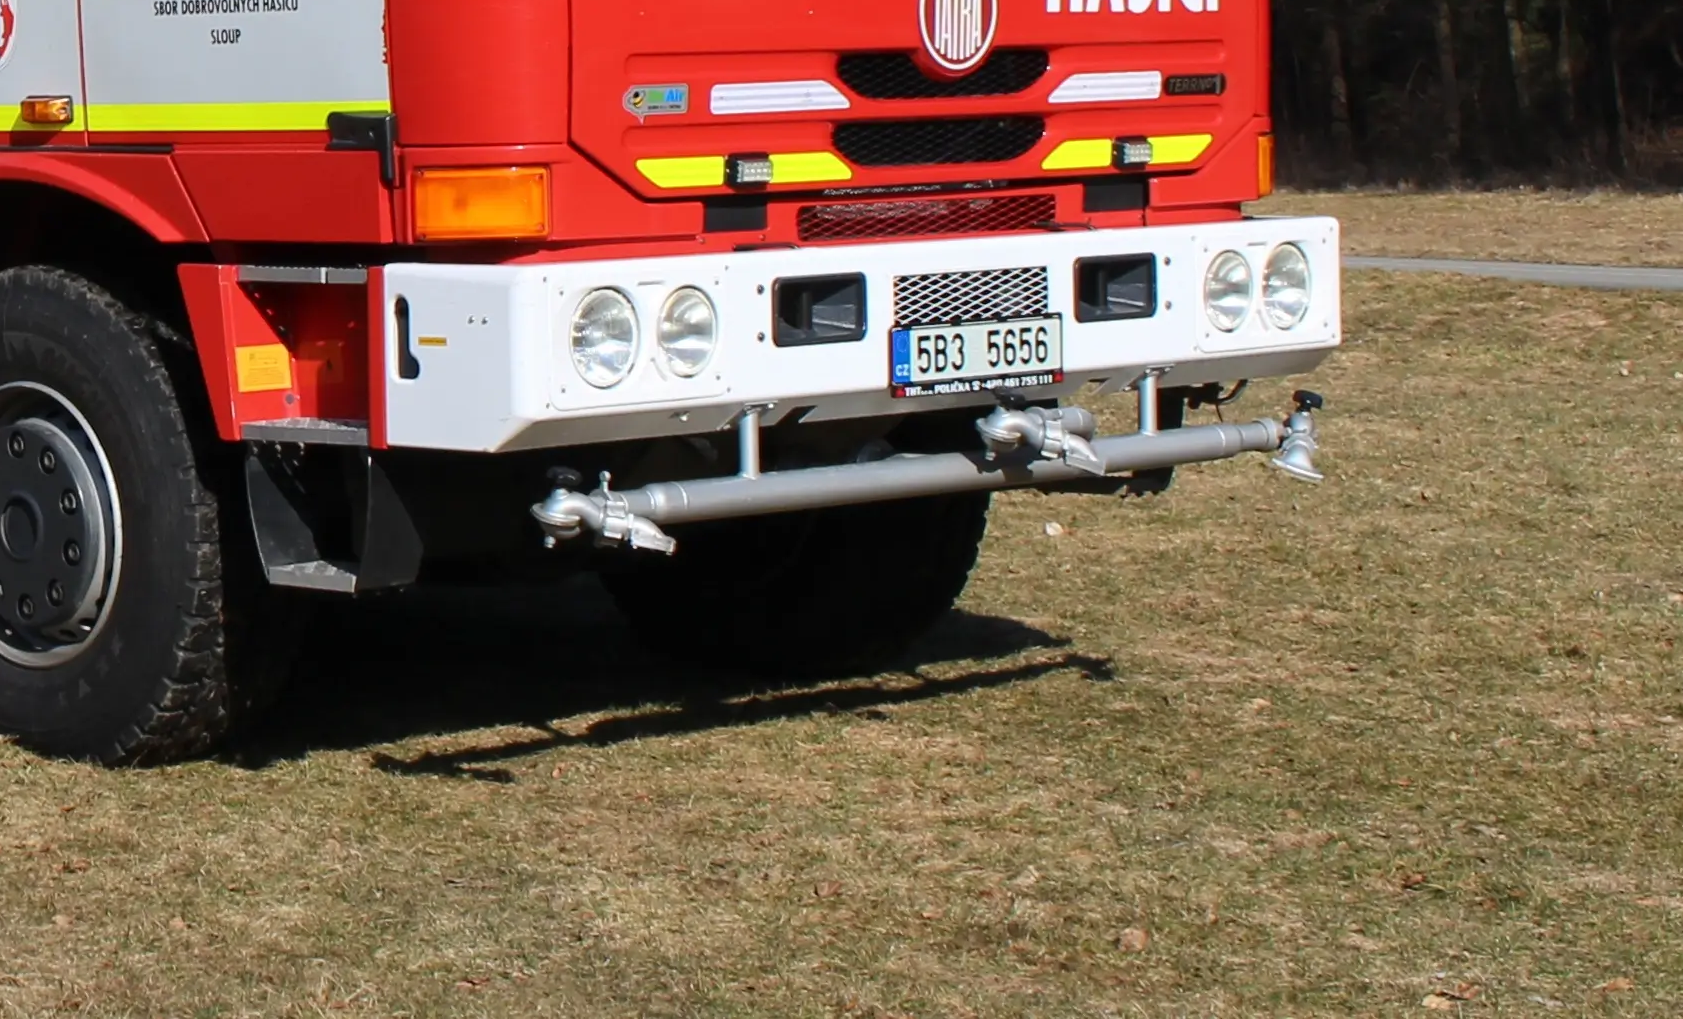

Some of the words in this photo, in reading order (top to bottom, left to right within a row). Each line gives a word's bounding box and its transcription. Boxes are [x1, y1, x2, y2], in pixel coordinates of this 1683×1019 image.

[153, 0, 179, 16] SBOR
[210, 28, 242, 45] SLOUP
[917, 333, 965, 374] 5B3
[986, 326, 1048, 369] 5656
[895, 364, 910, 377] CZ
